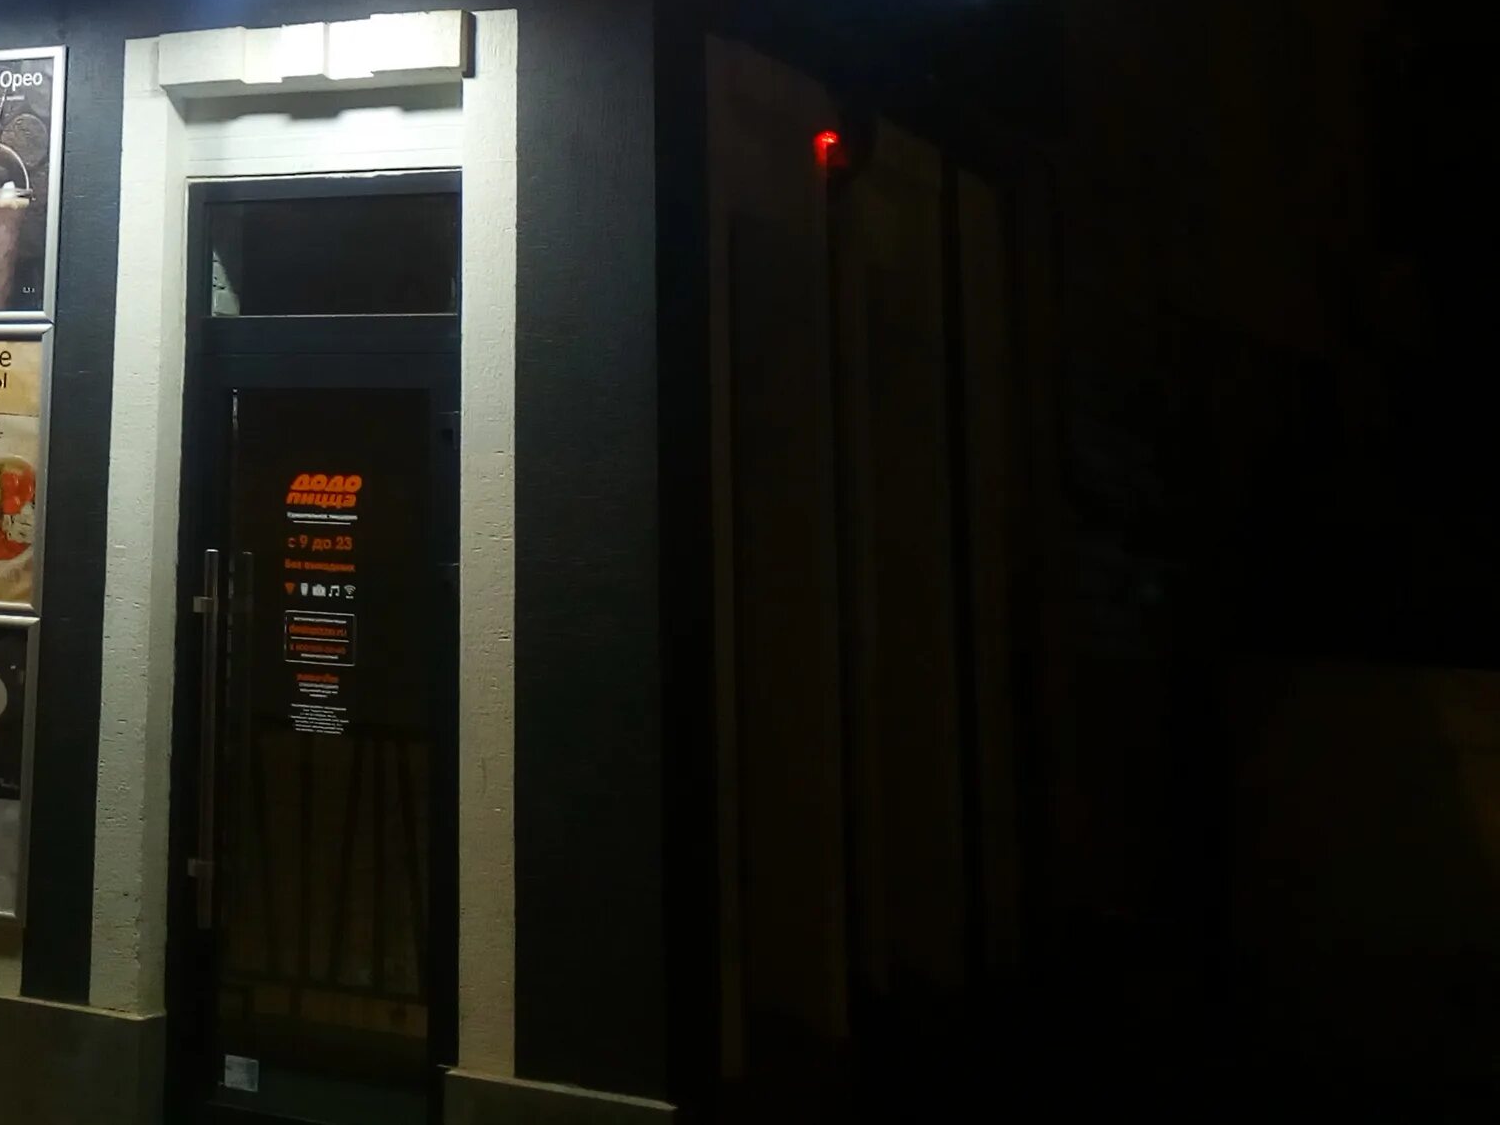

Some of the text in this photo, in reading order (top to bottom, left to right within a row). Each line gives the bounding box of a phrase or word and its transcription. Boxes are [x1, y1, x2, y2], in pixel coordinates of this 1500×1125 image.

[0, 70, 43, 92] Орео
[299, 534, 308, 549] 9
[311, 538, 332, 552] до
[335, 536, 353, 551] 23
